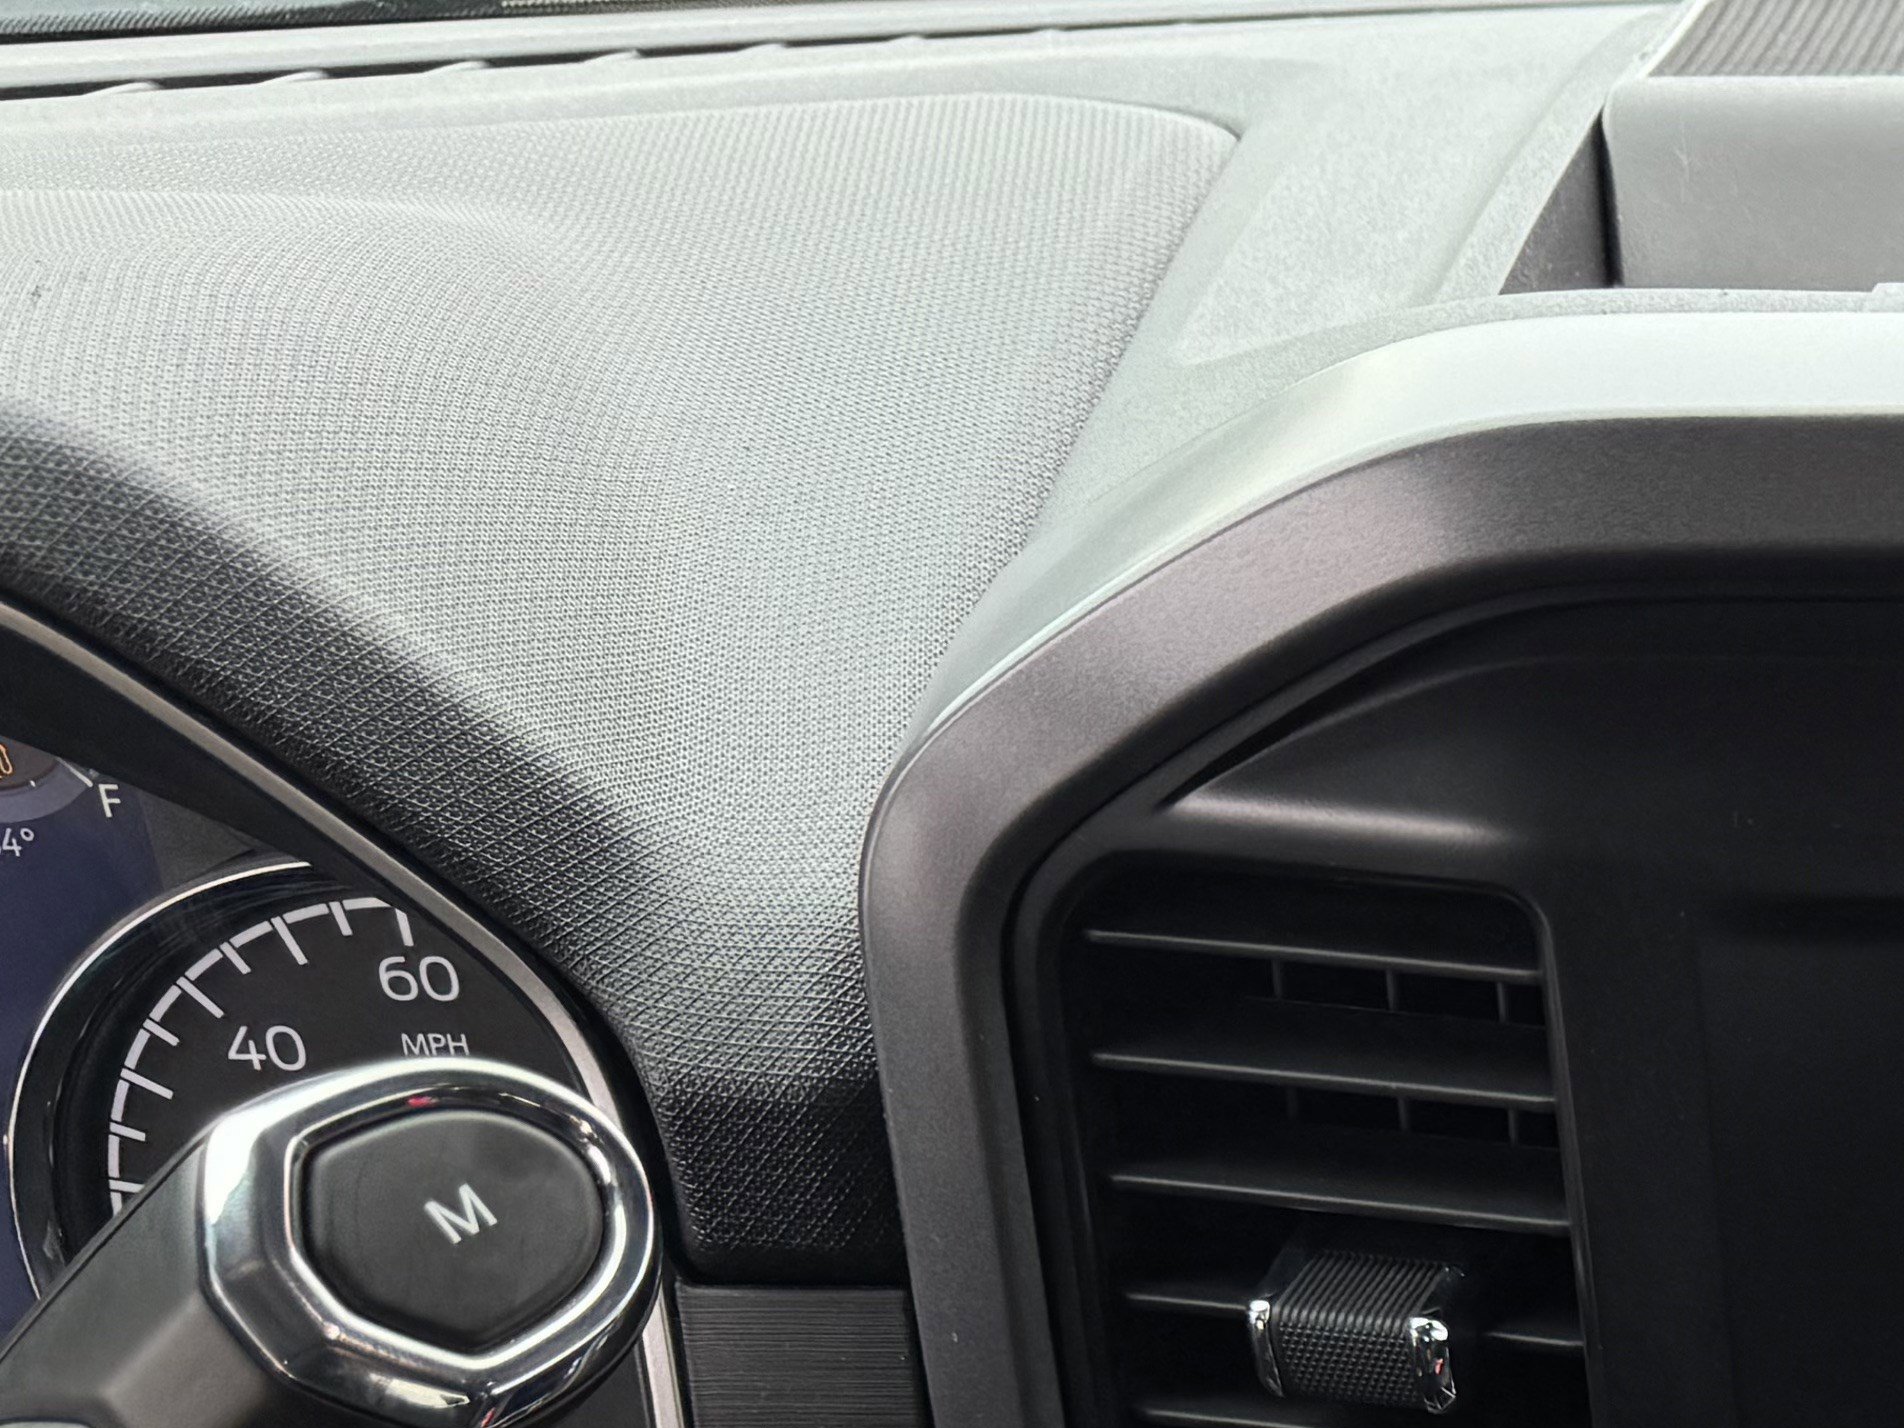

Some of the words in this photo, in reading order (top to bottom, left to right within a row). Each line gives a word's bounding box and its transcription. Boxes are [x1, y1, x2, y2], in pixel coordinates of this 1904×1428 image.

[98, 783, 121, 818] F
[378, 953, 461, 1002] 60
[227, 1023, 308, 1072] 40
[400, 1031, 469, 1059] MPH
[424, 1182, 499, 1245] M
